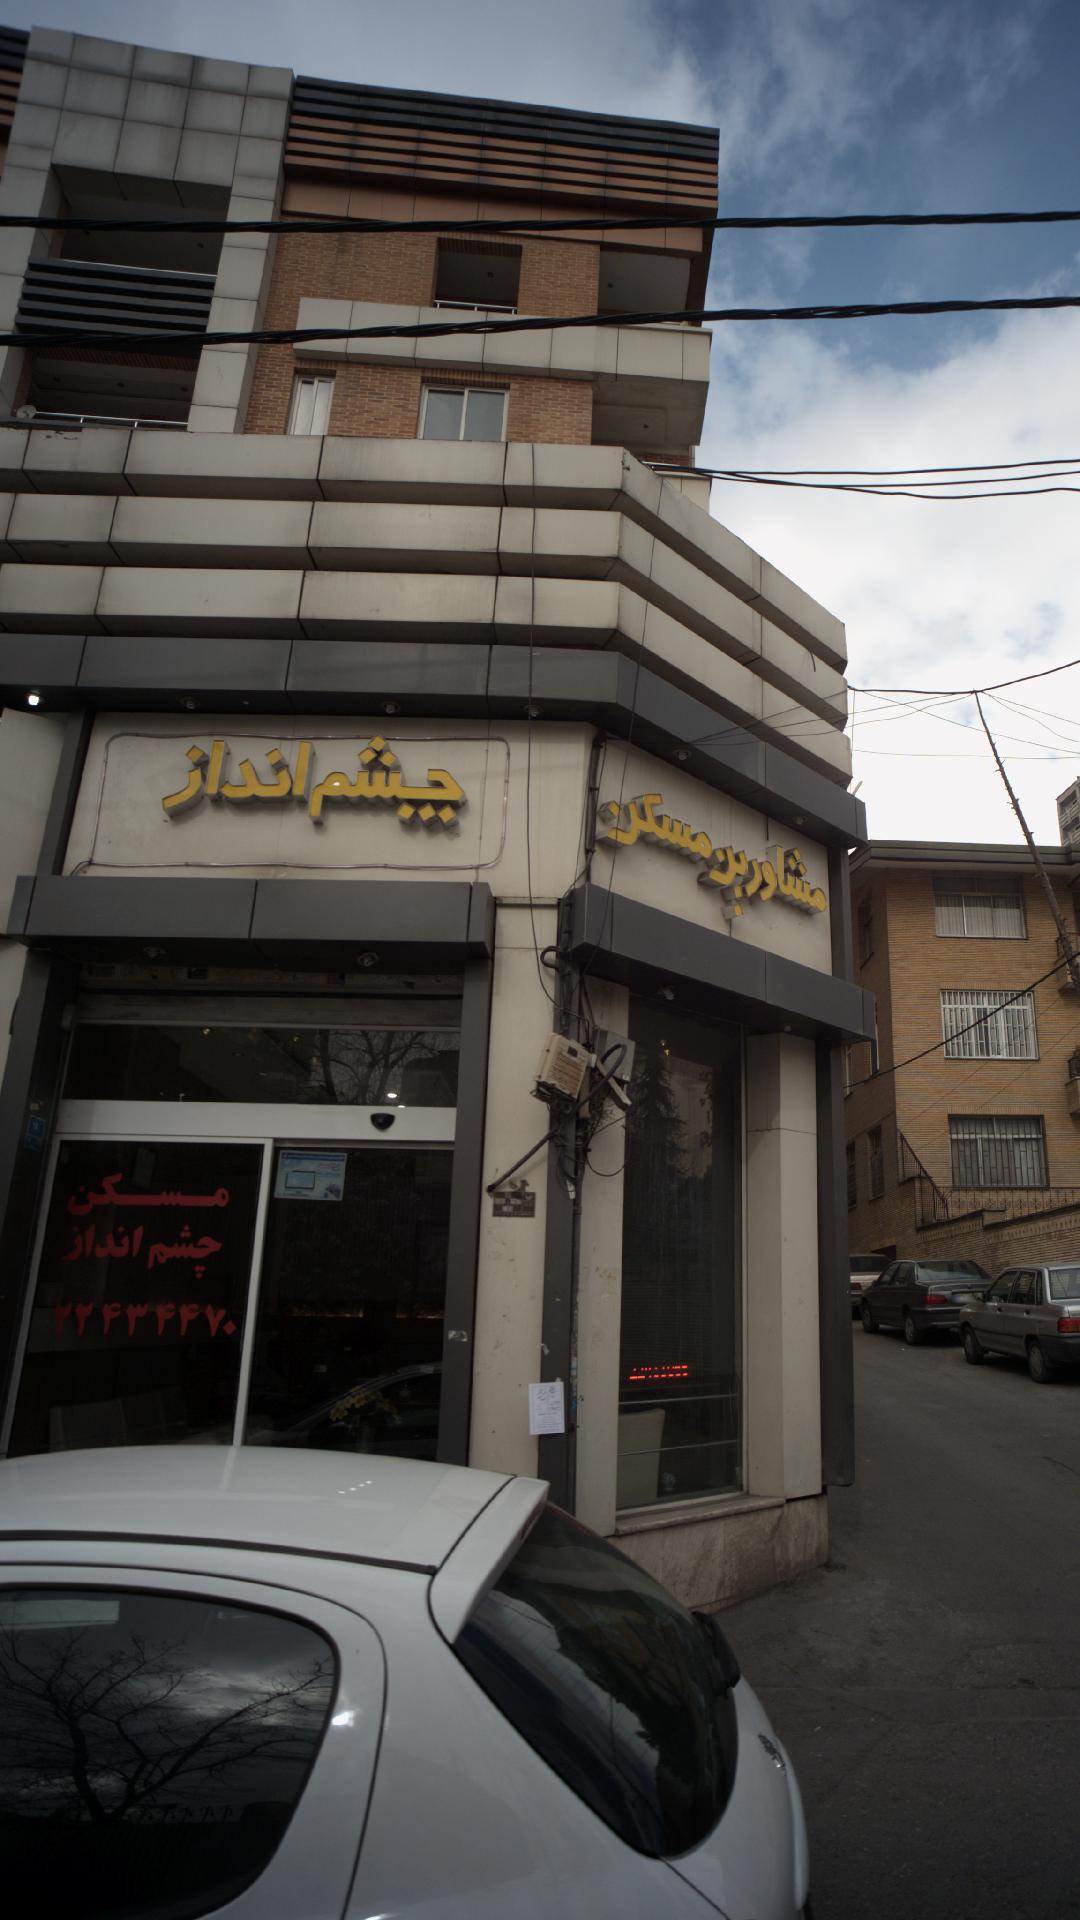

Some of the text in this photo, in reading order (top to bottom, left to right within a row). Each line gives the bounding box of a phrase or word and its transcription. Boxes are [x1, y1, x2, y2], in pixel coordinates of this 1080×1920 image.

[162, 736, 467, 824] چشم انداز
[600, 793, 827, 918] مشاورین مسکن
[67, 1172, 230, 1215] مسکن
[61, 1224, 223, 1279] چشم انداز
